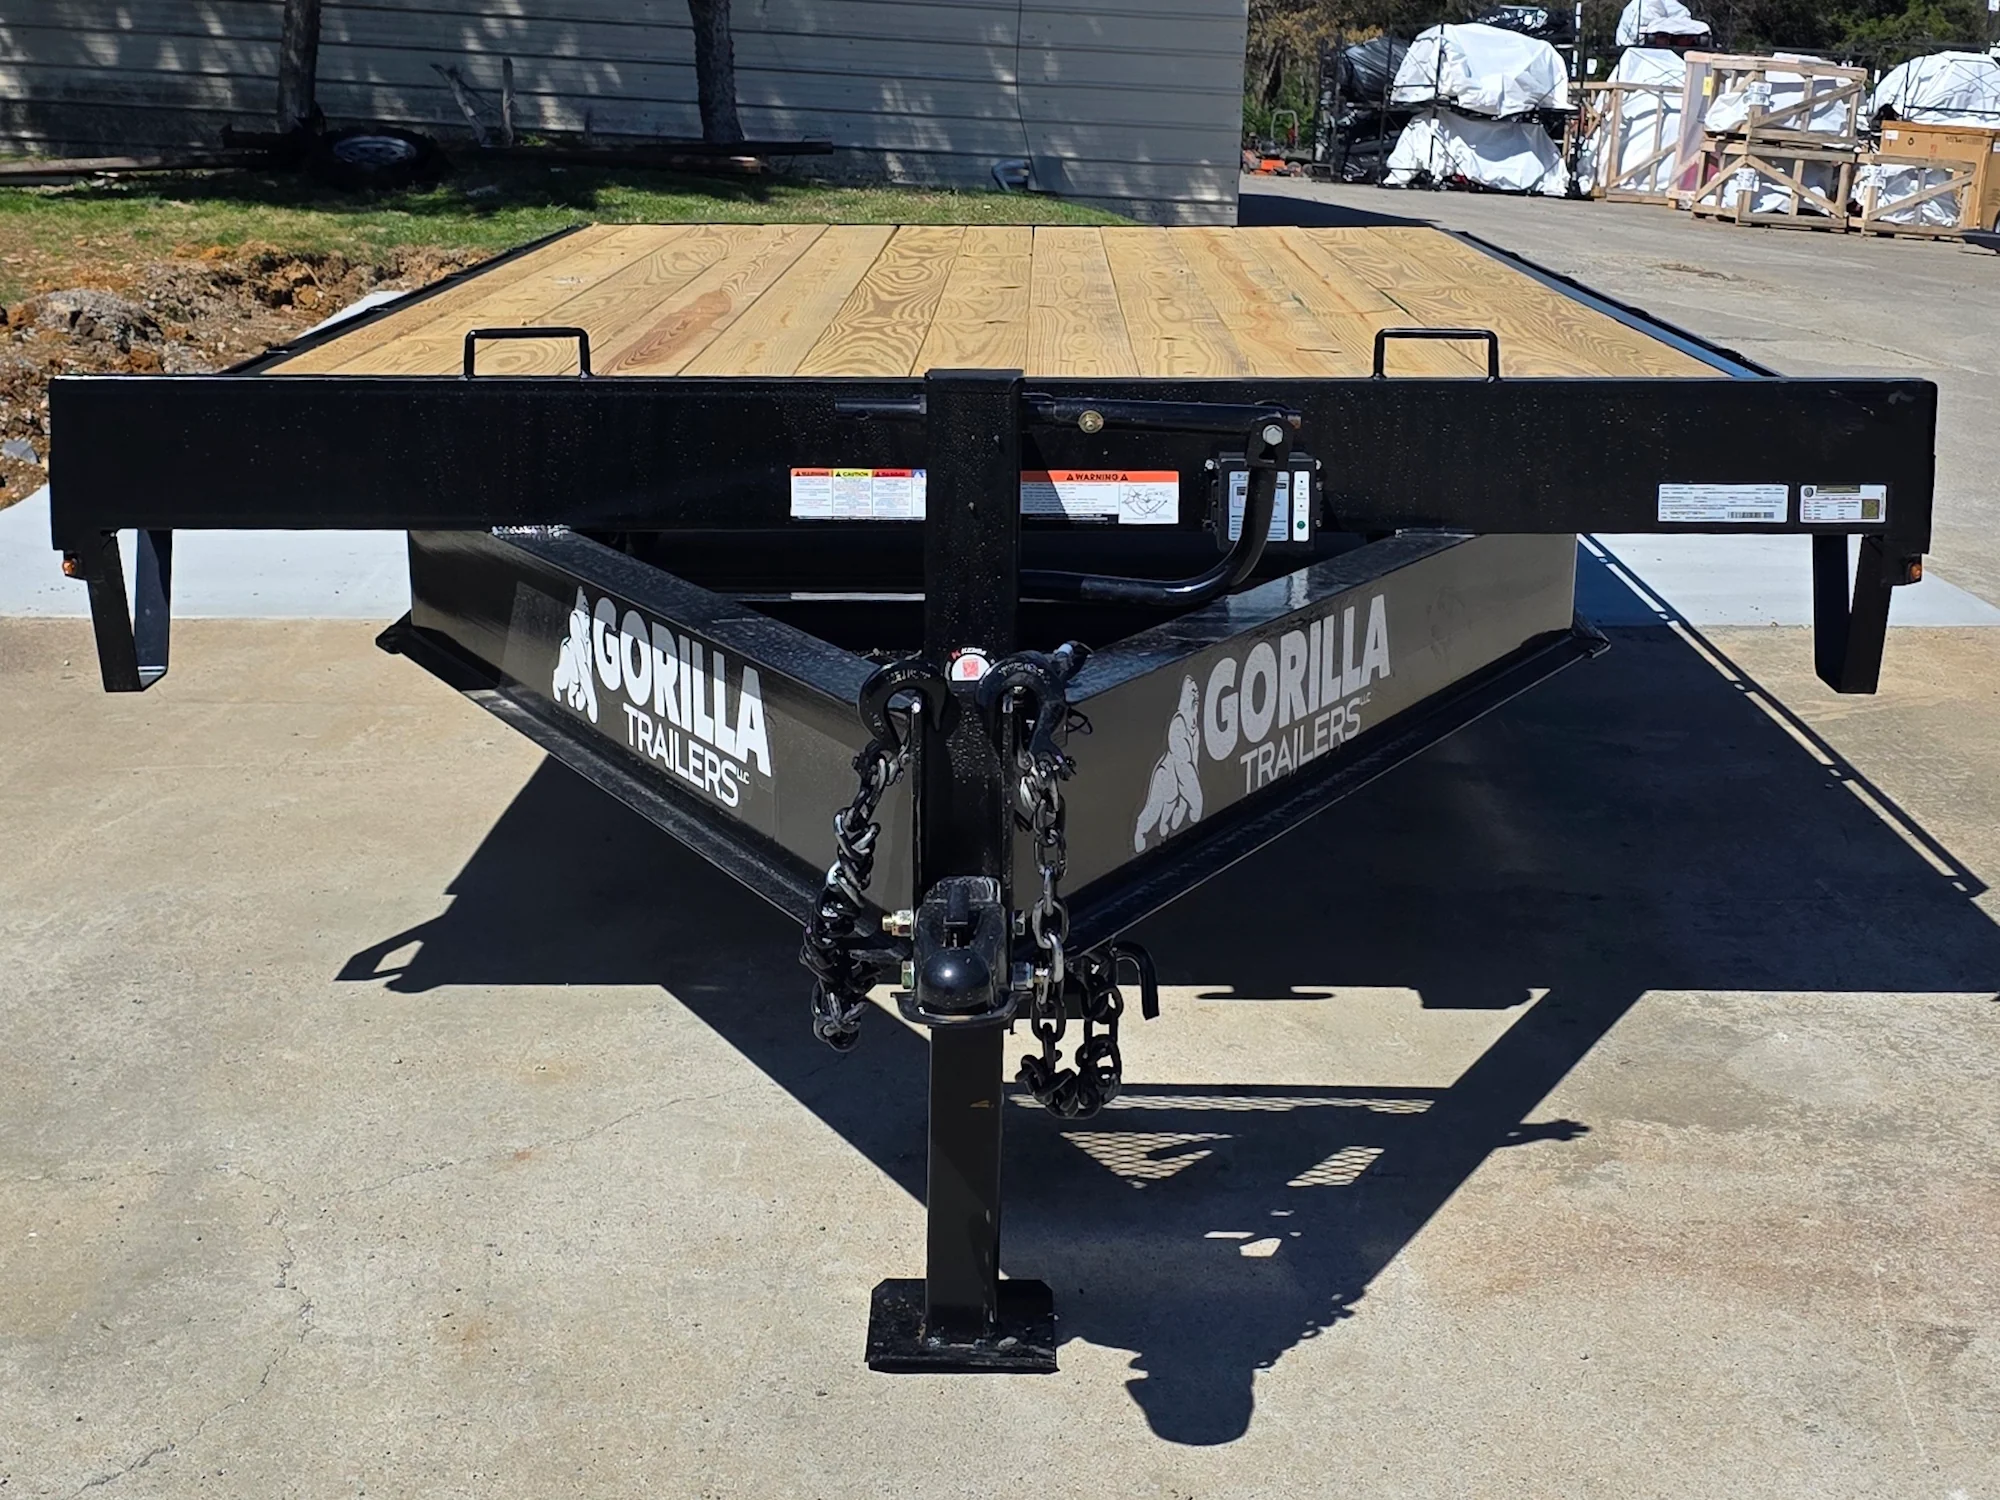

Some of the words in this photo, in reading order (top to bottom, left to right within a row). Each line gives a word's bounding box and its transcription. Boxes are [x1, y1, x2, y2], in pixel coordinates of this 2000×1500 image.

[1075, 473, 1119, 481] WARNING
[593, 597, 772, 777] GORILLA
[1203, 594, 1391, 761] GORILLA
[623, 702, 739, 808] TRAILERS
[736, 767, 750, 785] LLC
[1240, 696, 1361, 794] TRAILERS
